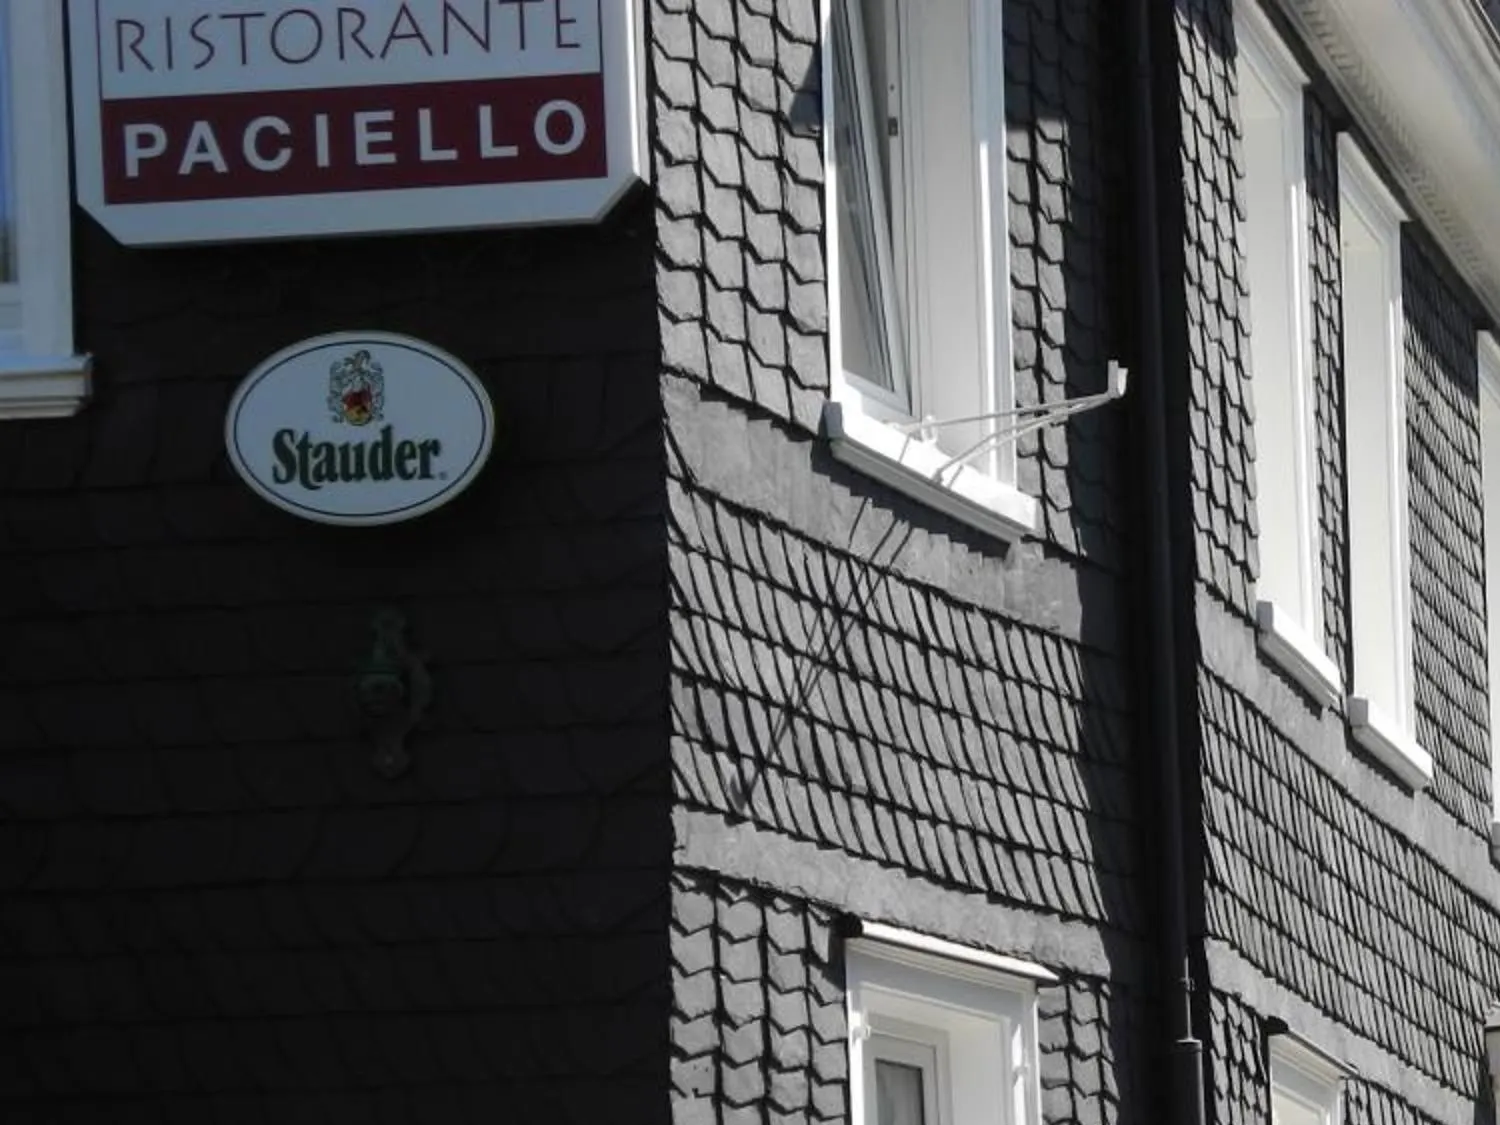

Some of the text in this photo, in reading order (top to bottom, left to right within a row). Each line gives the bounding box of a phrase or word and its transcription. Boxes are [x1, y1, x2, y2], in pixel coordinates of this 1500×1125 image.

[115, 0, 582, 73] RISTORANTE
[123, 98, 588, 179] PACIELLO
[272, 424, 442, 491] Stauder
